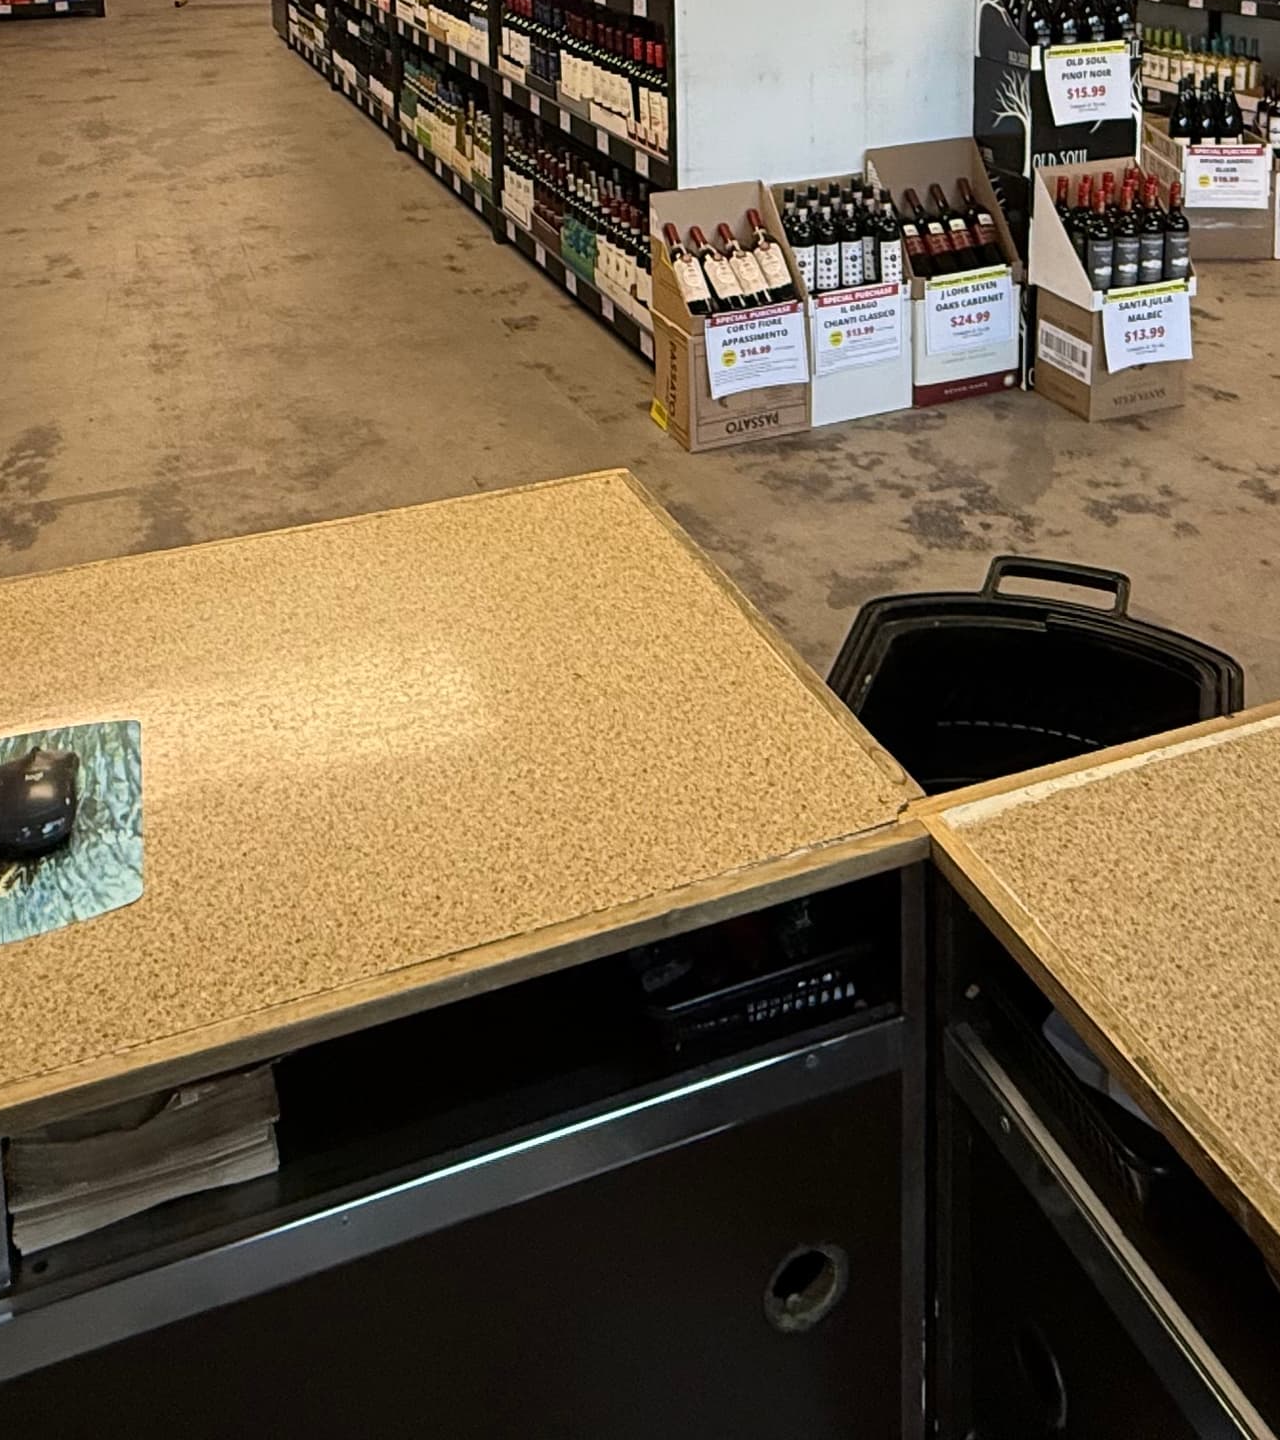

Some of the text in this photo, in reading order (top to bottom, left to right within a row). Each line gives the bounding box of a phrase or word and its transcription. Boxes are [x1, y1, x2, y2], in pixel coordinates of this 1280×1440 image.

[1066, 56, 1108, 67] OLD SOUL
[1062, 69, 1111, 81] PINOT NOIR
[1067, 85, 1106, 99] $15.99
[947, 285, 969, 297] LOHR
[971, 281, 997, 292] SEVEN
[823, 294, 853, 304] SPECIAL
[850, 301, 878, 312] DRAGO
[936, 293, 1004, 312] OAKS CABERNET
[1118, 296, 1173, 310] SANTA JULIA
[716, 305, 791, 325] SPECIAL PURCHASE
[824, 309, 895, 328] CHIANTI CLASSICO
[950, 311, 990, 327] $24.99
[1128, 310, 1163, 323] MALBEC
[727, 318, 782, 334] CORTO FIORE
[722, 329, 788, 347] APPASSIMENTO
[1124, 326, 1165, 344] $13.99
[726, 411, 779, 435] PASSATO
